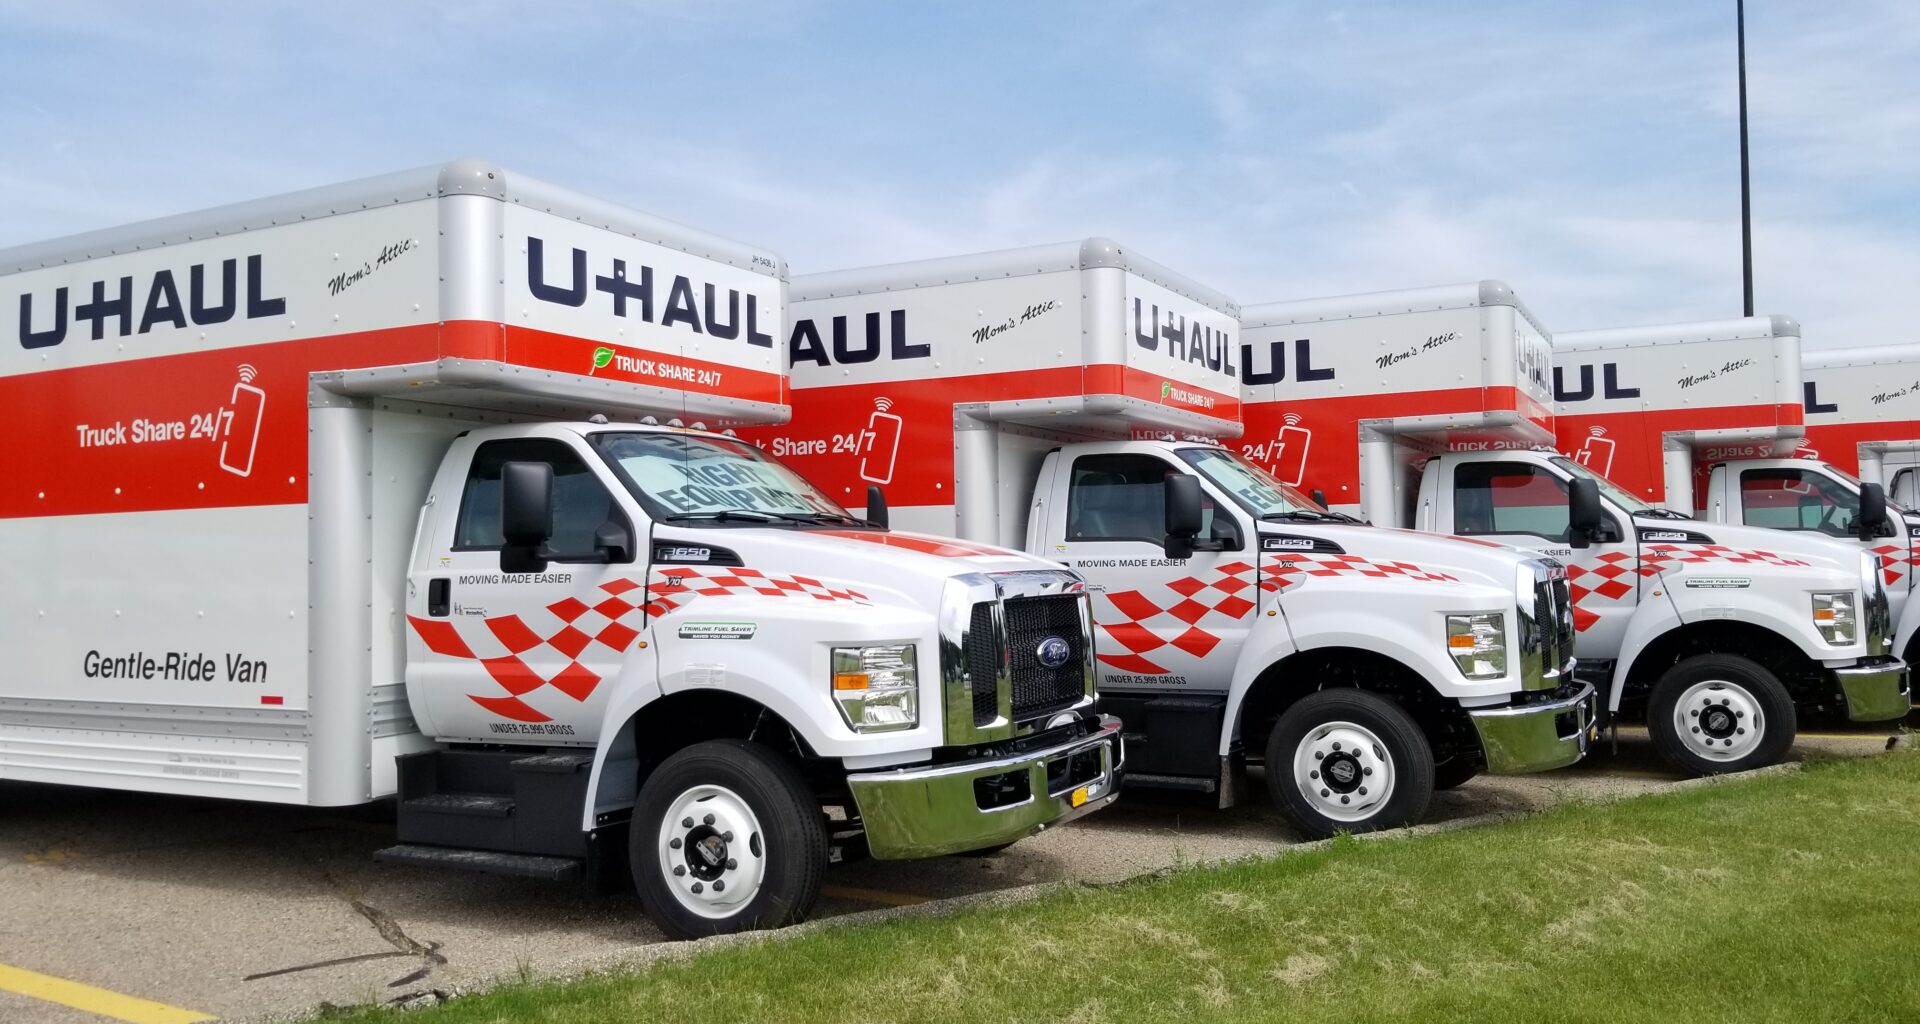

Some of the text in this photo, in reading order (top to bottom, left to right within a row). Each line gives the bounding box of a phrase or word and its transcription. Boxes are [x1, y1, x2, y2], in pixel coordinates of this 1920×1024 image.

[328, 239, 410, 296] Mom's Attic
[972, 300, 1054, 344] Mom's Attic
[1376, 332, 1455, 369] Mom's Attic
[615, 355, 723, 387] TRUCK SHARE 24/7
[1677, 358, 1750, 389] Mom's Attic
[1170, 387, 1215, 410] TRUCK SHARE 24/7
[1871, 388, 1906, 405] Mom's
[76, 406, 235, 448] Truck Share 24/7
[772, 437, 827, 457] Share
[832, 429, 877, 456] 24/7
[1242, 438, 1286, 463] 24/7
[668, 462, 770, 488] RIGHT
[1077, 558, 1187, 568] MOVING MADE EASIER
[459, 573, 572, 585] MOVING MADE EASIER
[84, 650, 268, 683] Gentle-Ride Van
[1105, 675, 1132, 684] UNDER
[1158, 676, 1187, 684] GROSS
[489, 723, 520, 734] UNDER
[545, 724, 575, 735] GROSS
